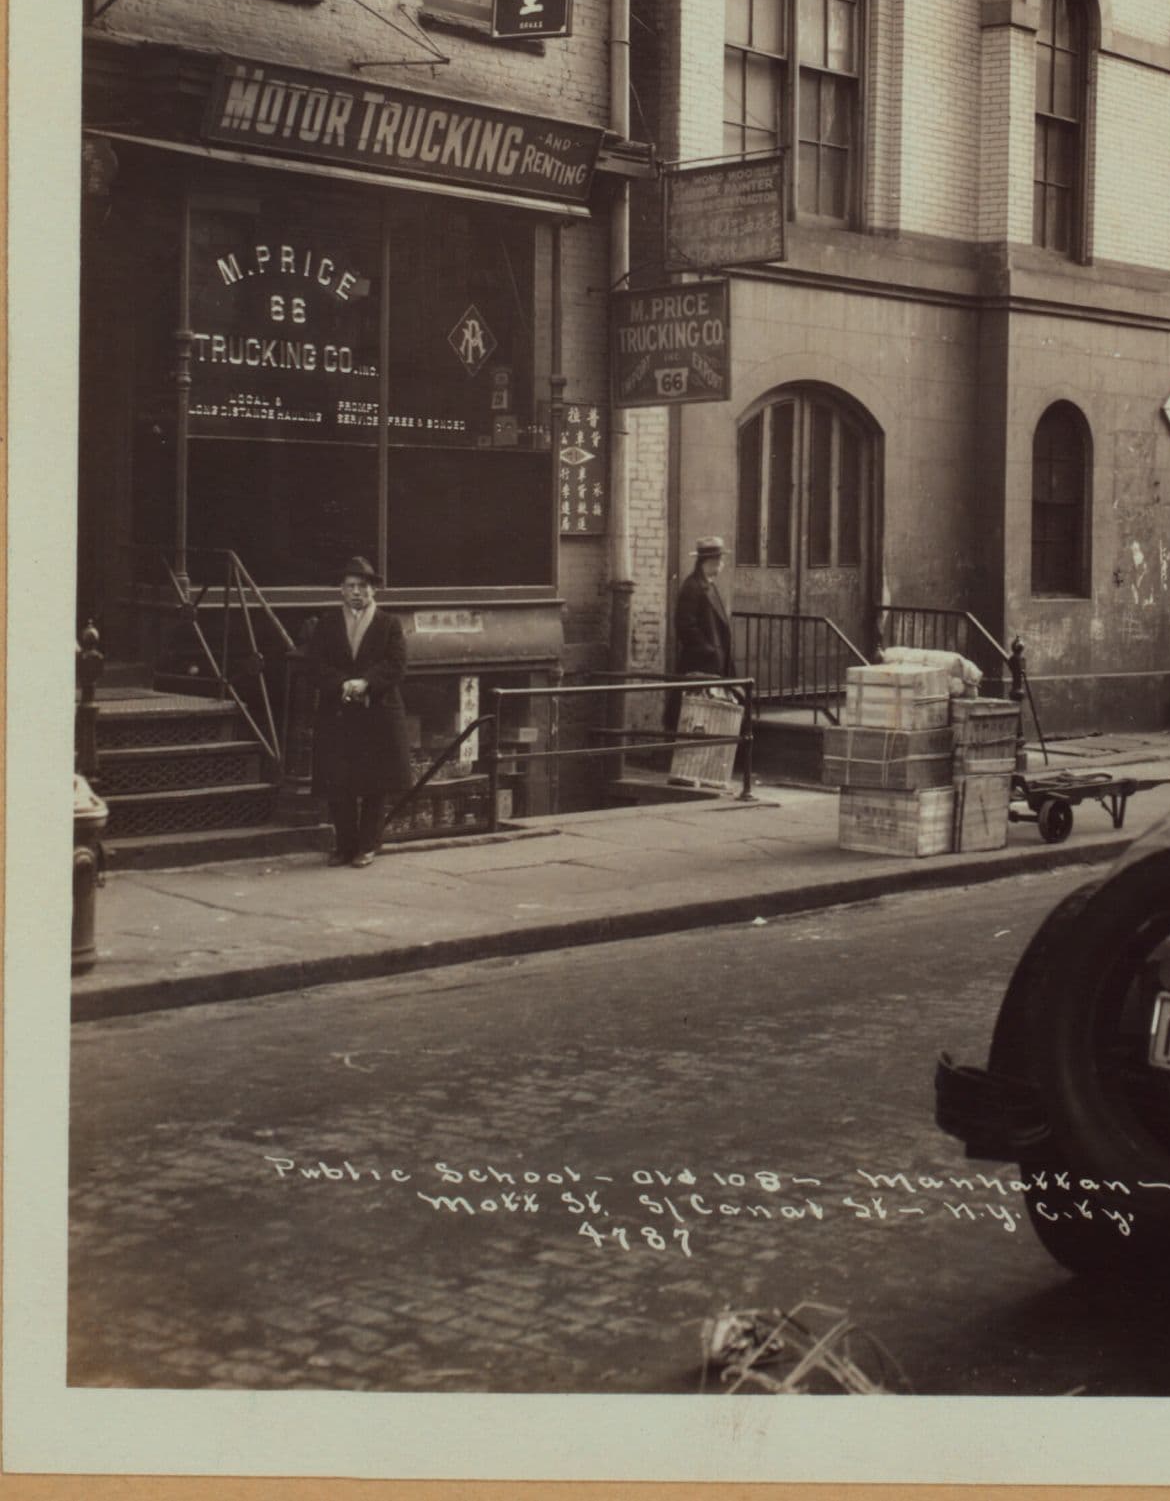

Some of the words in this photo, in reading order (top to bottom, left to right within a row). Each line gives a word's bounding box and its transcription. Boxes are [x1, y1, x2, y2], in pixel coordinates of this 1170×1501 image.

[220, 65, 354, 147] MOTOR
[357, 91, 524, 175] TRUCKING
[544, 132, 572, 150] AND
[520, 147, 588, 186] RENTING
[270, 294, 306, 323] 66
[619, 320, 701, 353] TRUCKING
[193, 334, 316, 371] TRUCKING
[661, 373, 683, 392] 66
[220, 405, 275, 420] DISTANCE
[337, 401, 379, 414] PROMPT
[337, 413, 379, 427] SERVICE
